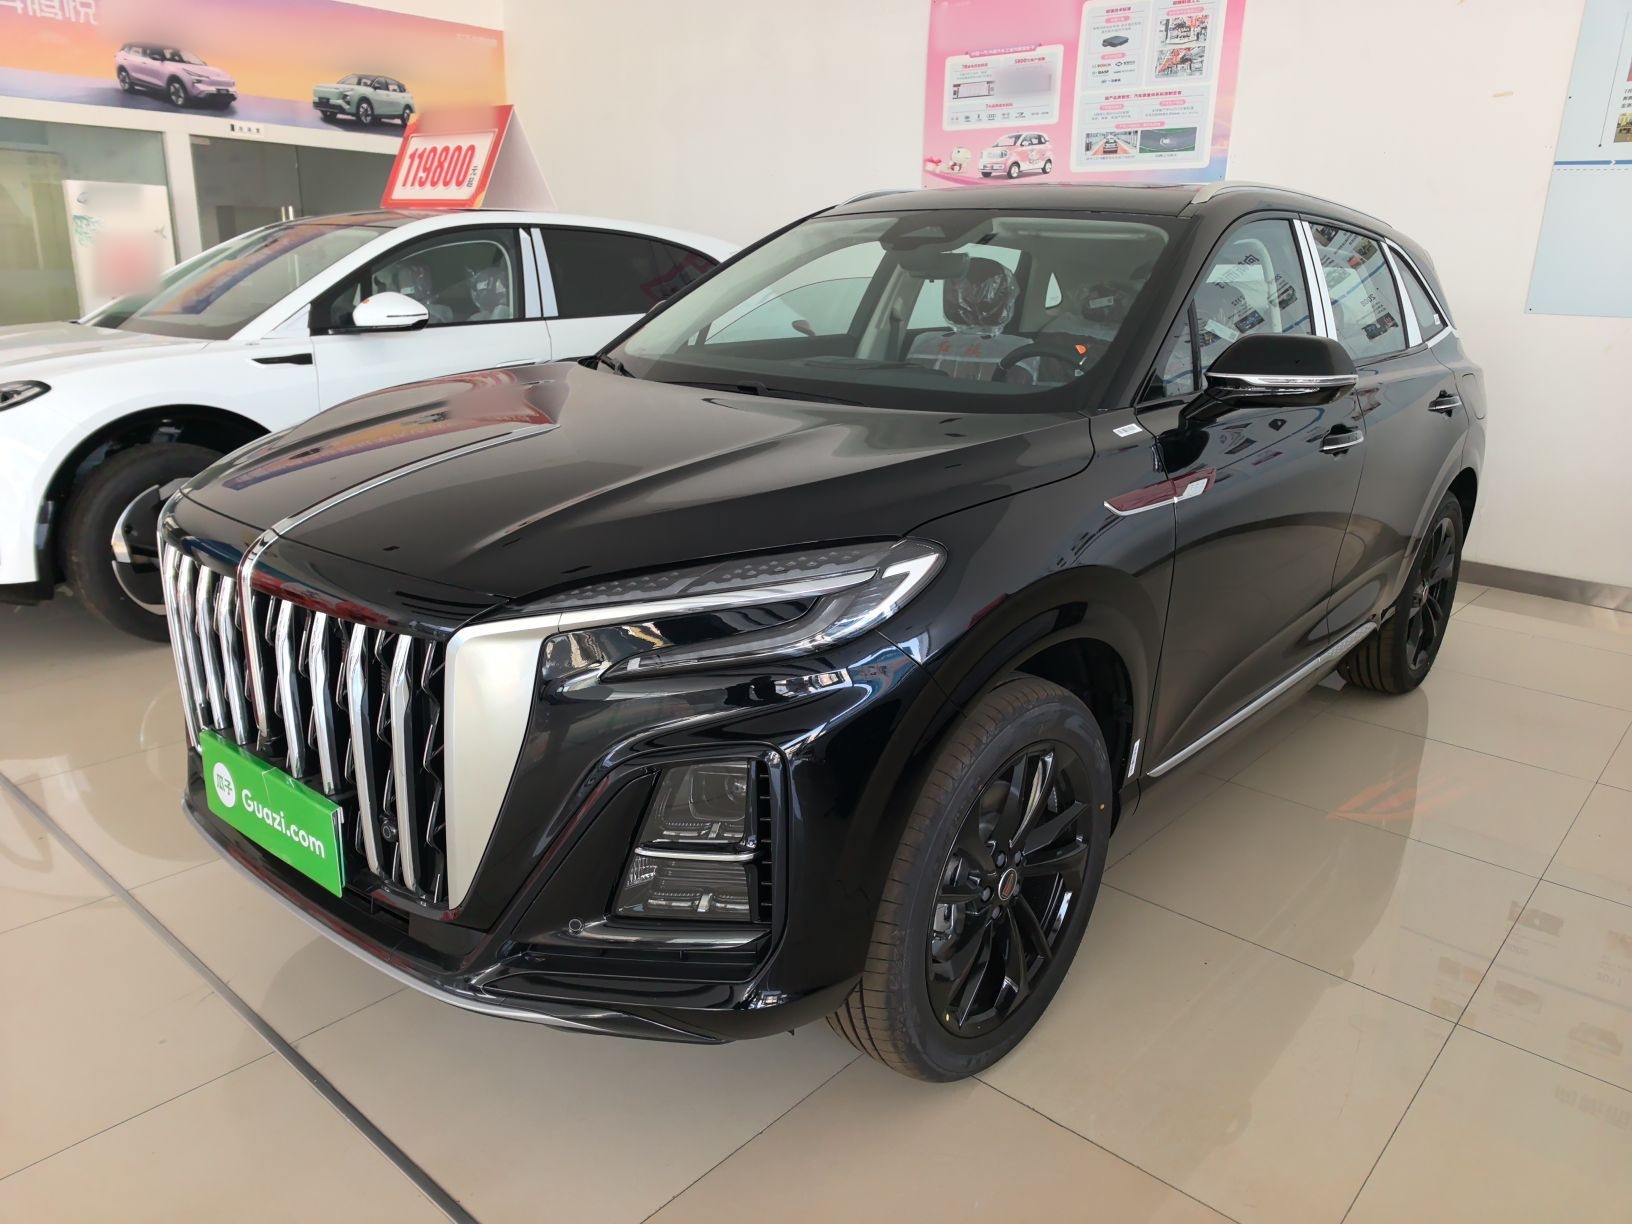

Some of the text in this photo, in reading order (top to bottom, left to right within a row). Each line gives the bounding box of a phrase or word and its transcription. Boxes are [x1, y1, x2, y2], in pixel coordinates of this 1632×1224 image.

[401, 144, 476, 187] 119800
[216, 773, 233, 796] 瓜子
[241, 789, 325, 859] Guazi.com
